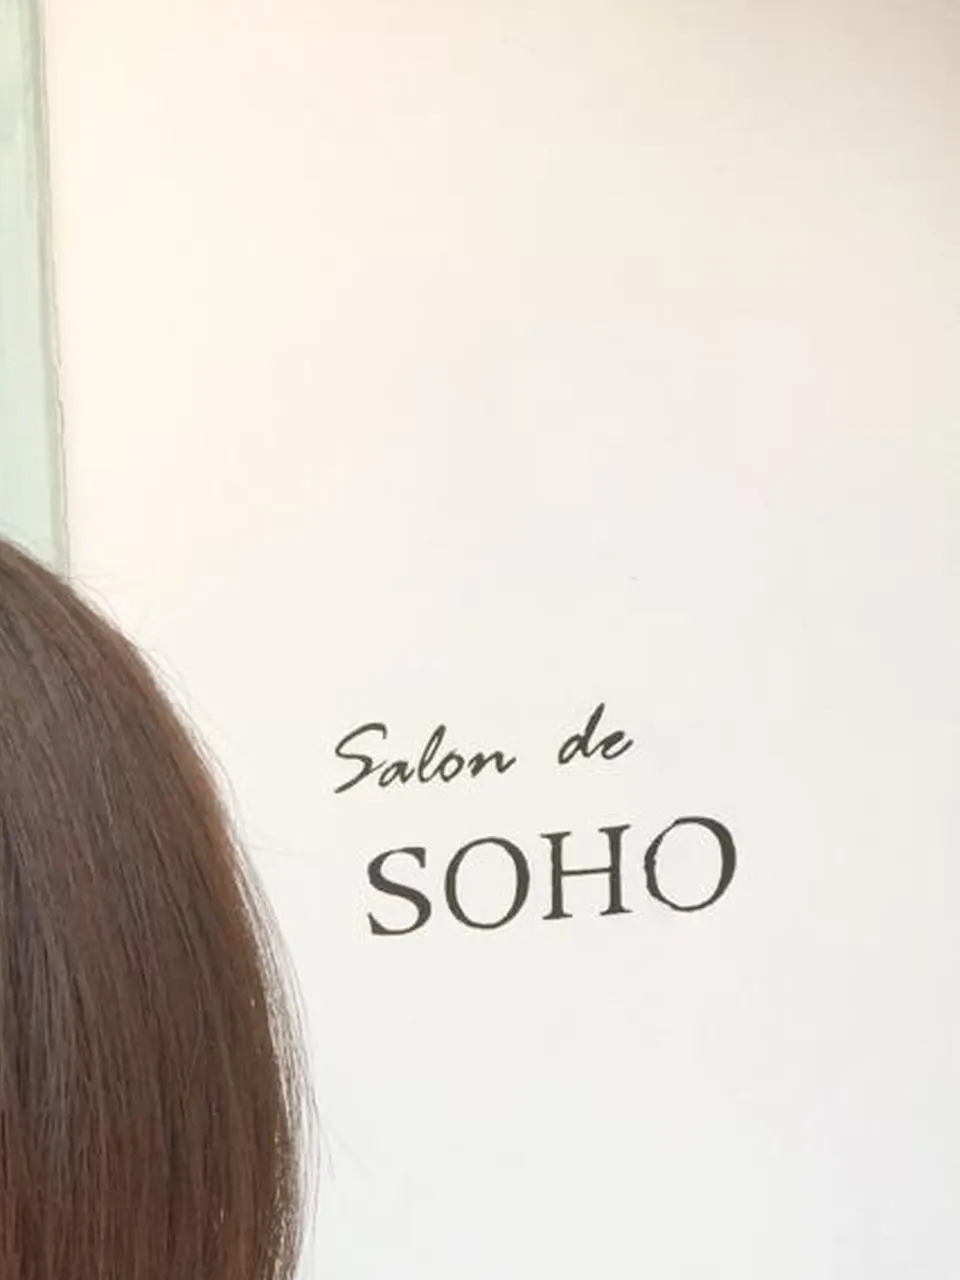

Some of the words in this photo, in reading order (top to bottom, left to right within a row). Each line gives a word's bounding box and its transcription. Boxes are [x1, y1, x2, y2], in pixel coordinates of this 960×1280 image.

[334, 722, 517, 794] Salon
[558, 703, 634, 765] de
[367, 816, 737, 936] SOHO
